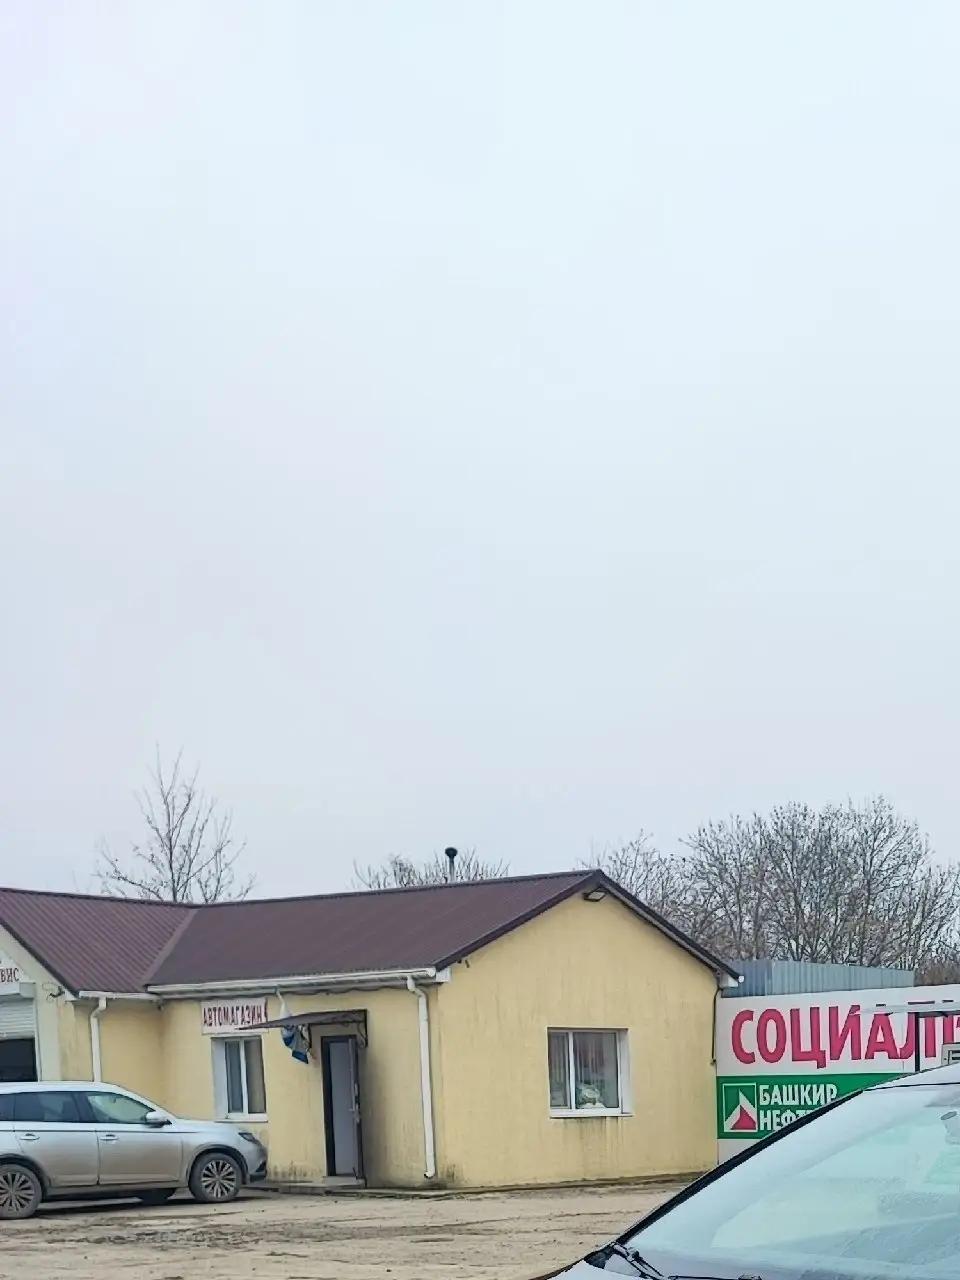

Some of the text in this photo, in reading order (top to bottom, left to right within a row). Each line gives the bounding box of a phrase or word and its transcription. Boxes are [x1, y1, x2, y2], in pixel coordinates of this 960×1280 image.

[203, 1005, 263, 1027] АВТОМАГАЗИН
[759, 1083, 838, 1105] БАШКИР
[759, 1109, 815, 1131] НЕФ
